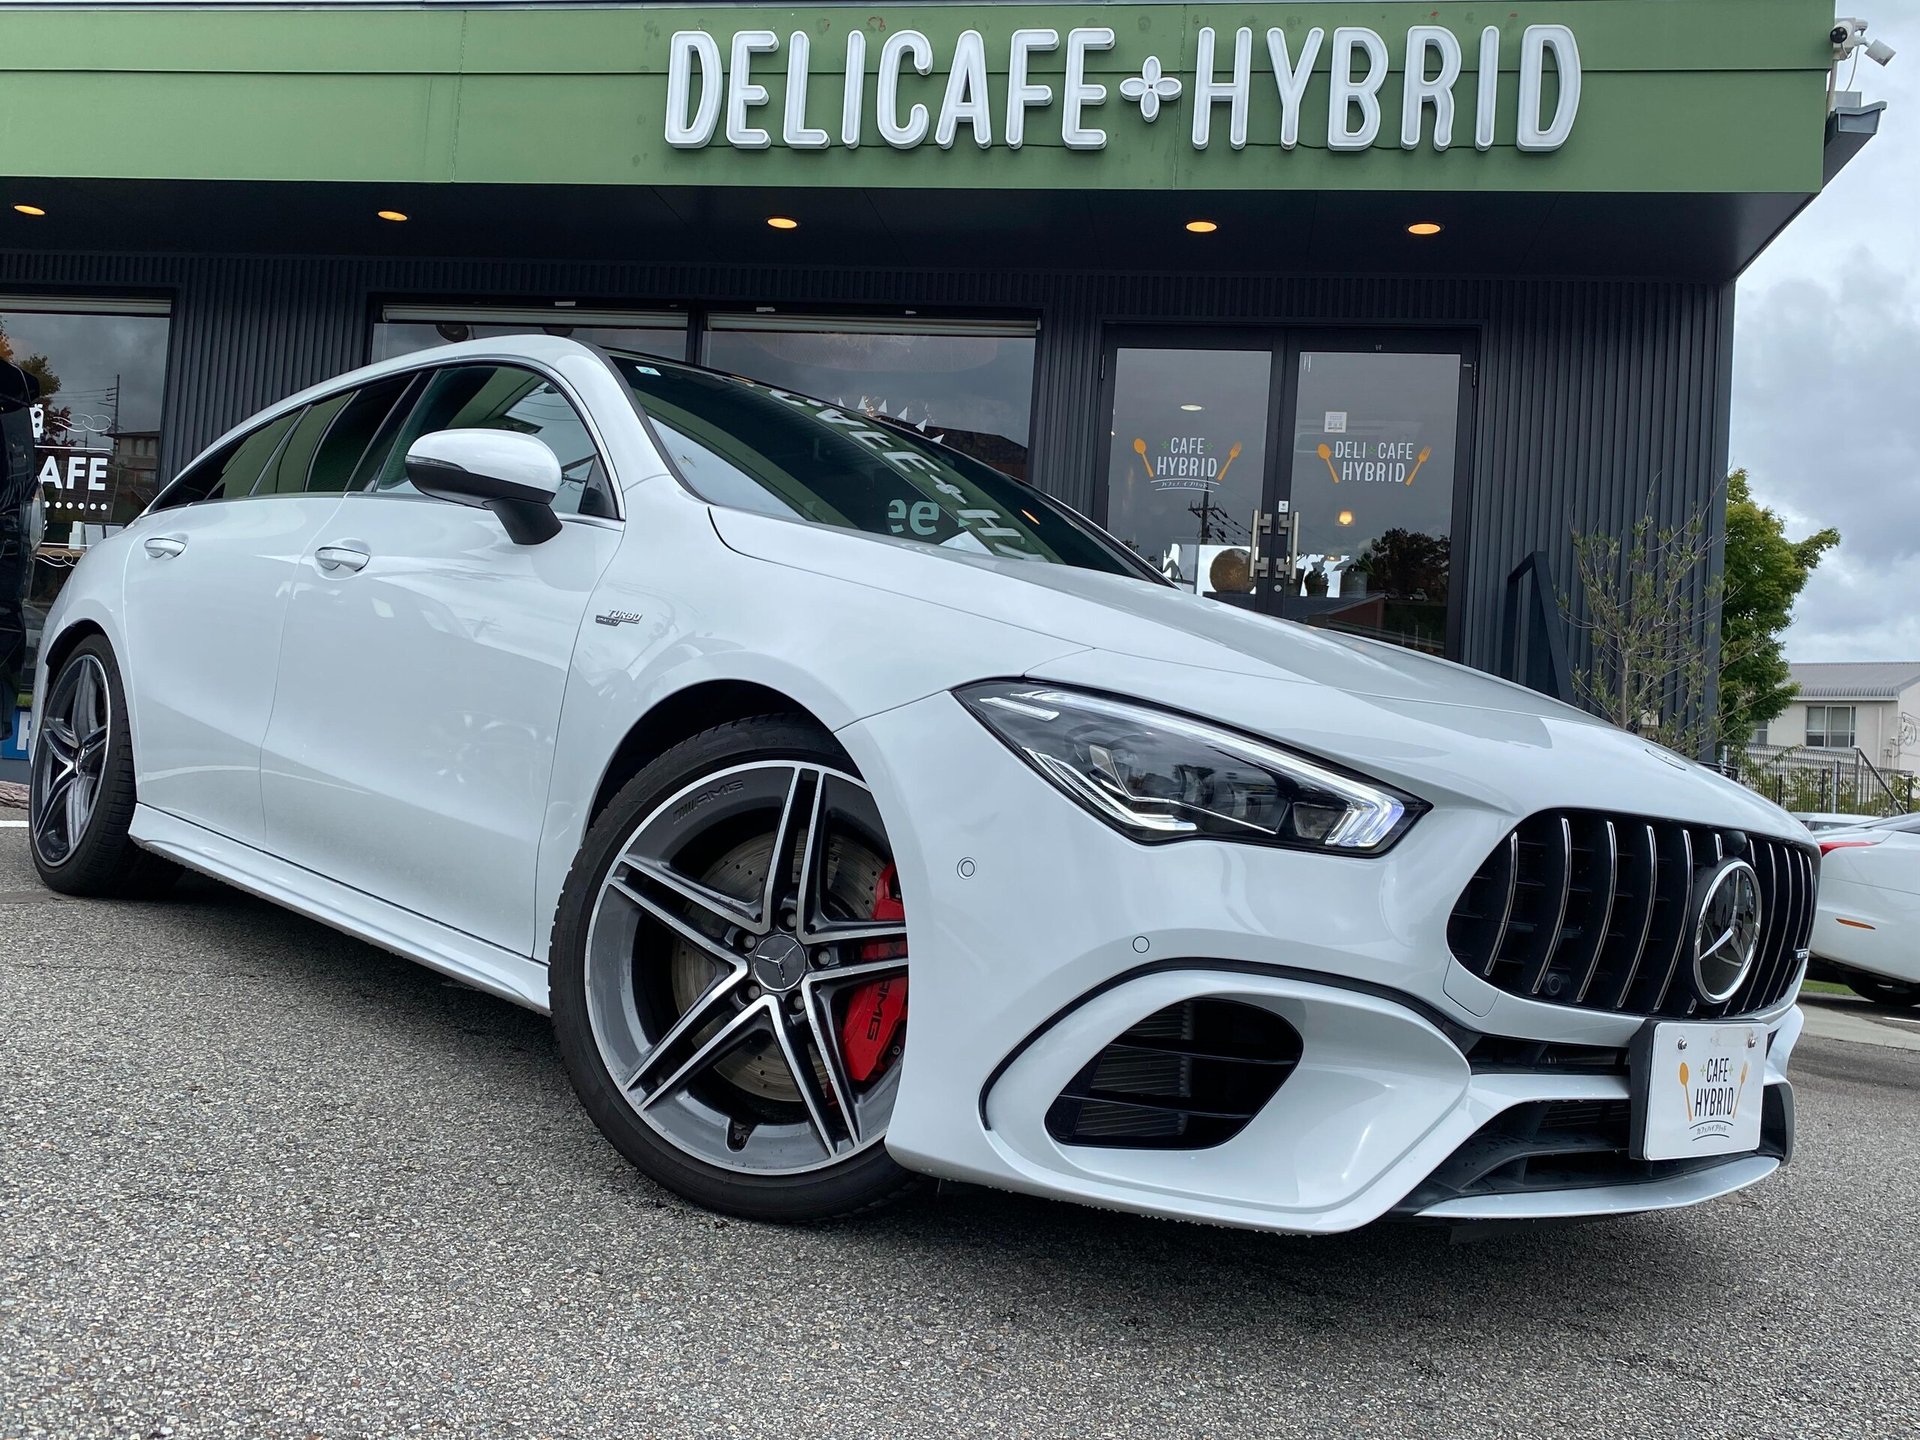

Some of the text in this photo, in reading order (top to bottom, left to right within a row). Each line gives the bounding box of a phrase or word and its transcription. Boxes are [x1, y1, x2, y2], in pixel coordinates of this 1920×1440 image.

[664, 24, 1582, 152] DELICAFE HYBRID
[1170, 436, 1206, 455] CAFE
[1334, 440, 1415, 460] DELI CAFE
[39, 455, 109, 491] AFE
[1156, 456, 1218, 477] HYBRID
[1341, 461, 1406, 483] HYBRID
[608, 609, 643, 622] TURBO
[1706, 1057, 1729, 1083] CAFE
[1694, 1086, 1734, 1118] HYBRID
